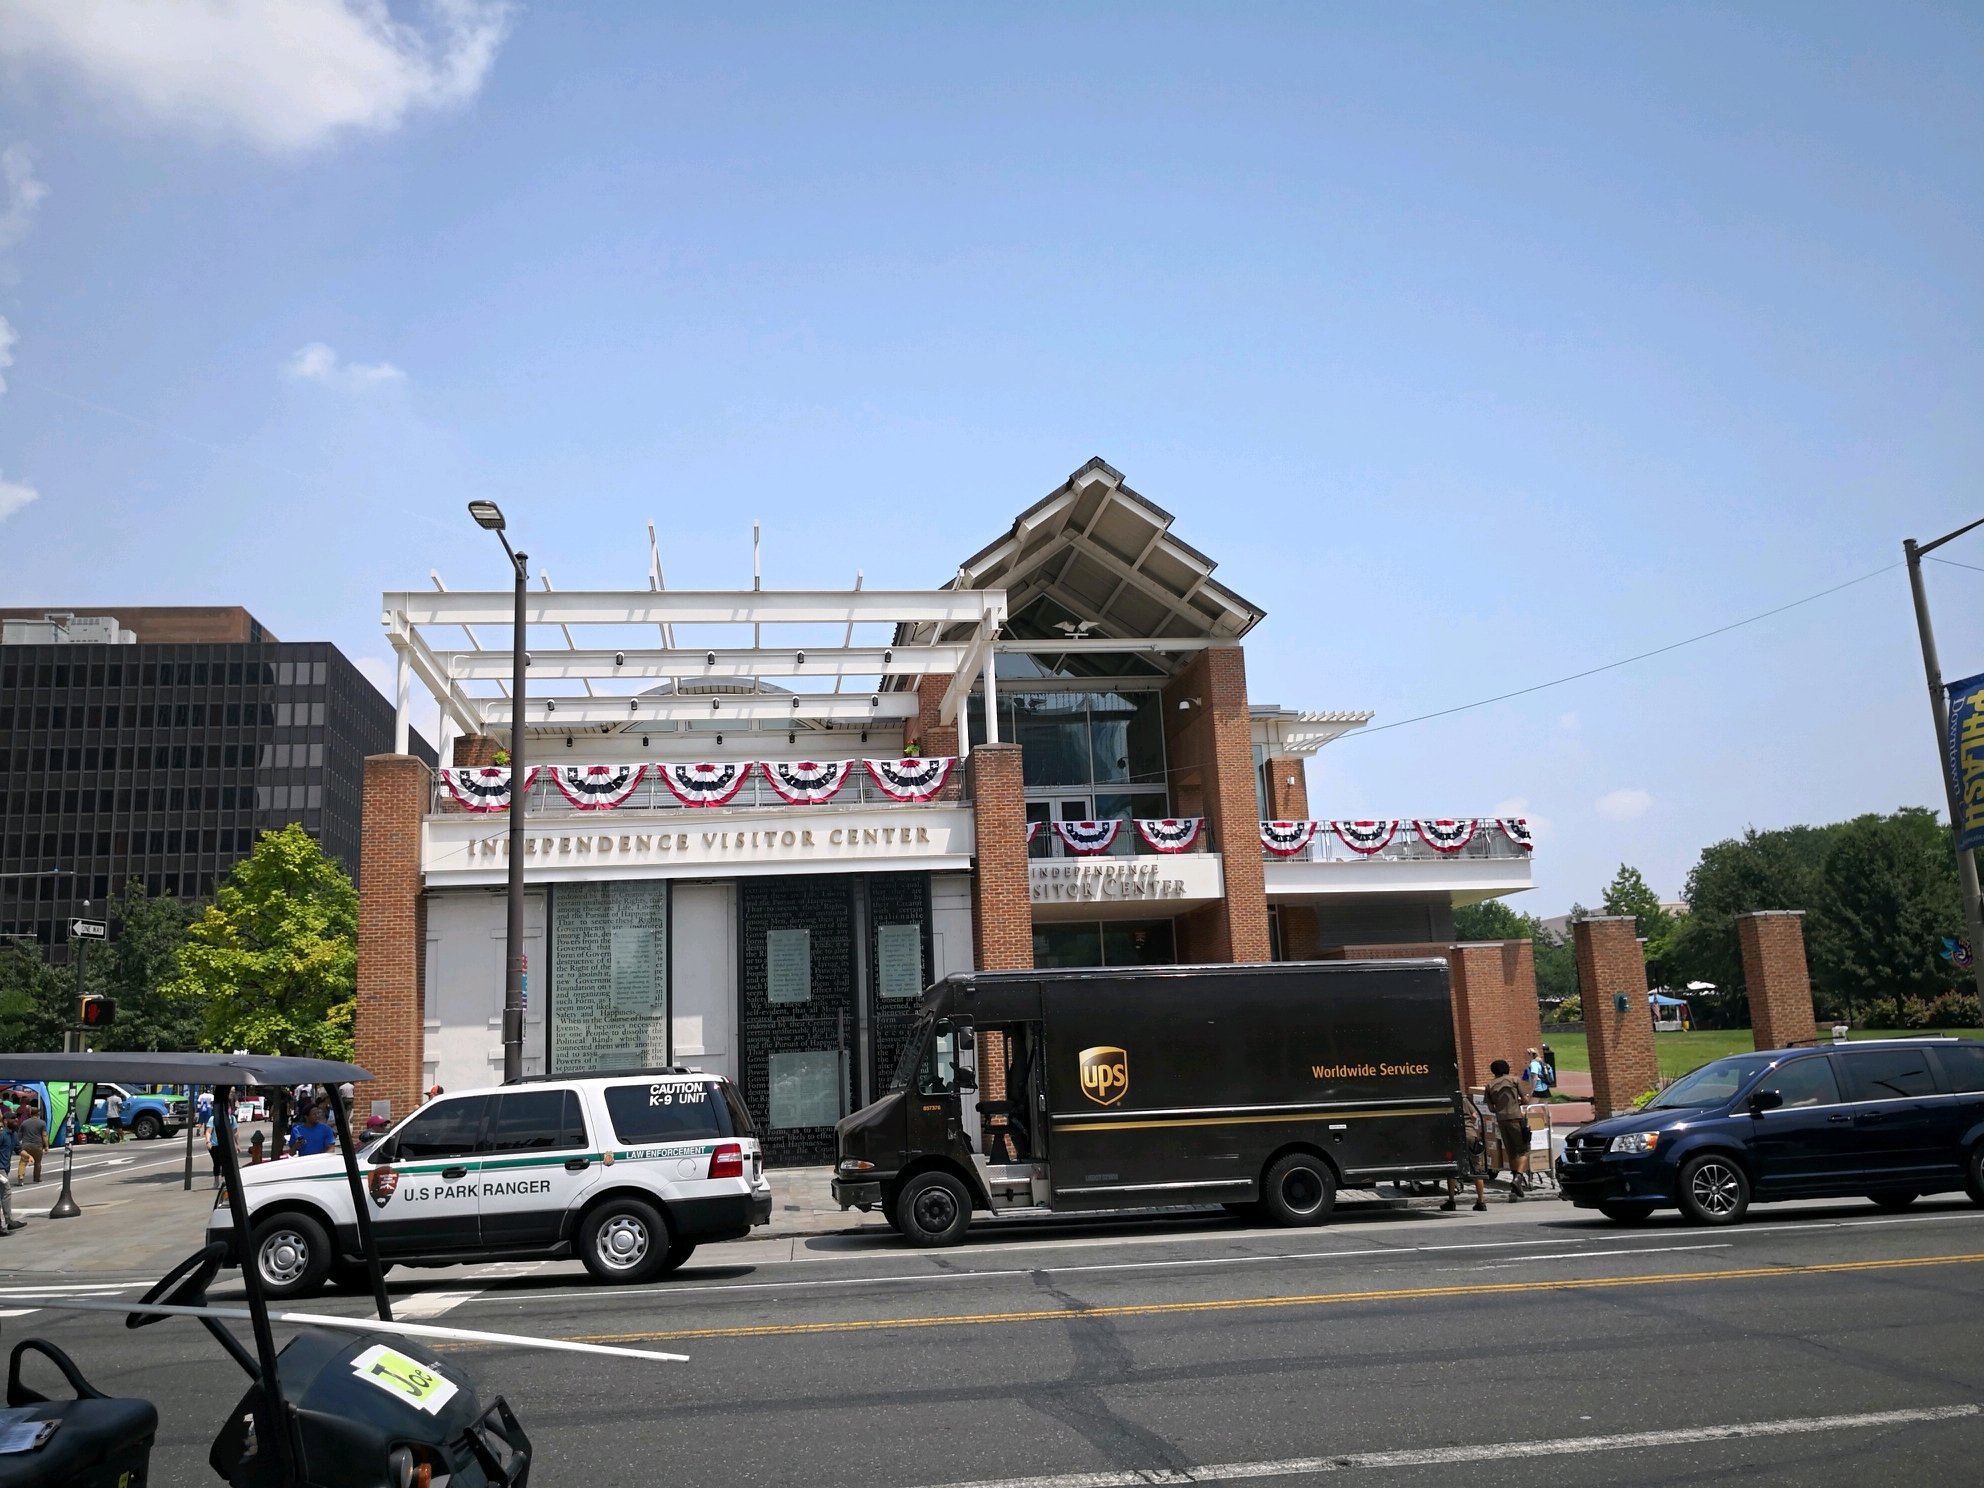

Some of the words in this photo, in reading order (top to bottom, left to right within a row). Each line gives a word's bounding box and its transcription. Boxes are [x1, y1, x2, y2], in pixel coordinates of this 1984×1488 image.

[1951, 695, 1966, 796] Downtown
[468, 833, 689, 857] INEPENDENCE
[702, 829, 815, 849] VISITOR
[829, 826, 930, 845] CENTER
[1032, 863, 1160, 879] INDEPENDENCE
[1103, 878, 1188, 897] CENTER
[1083, 1063, 1125, 1097] ups
[1312, 1064, 1377, 1079] Worldwide
[1379, 1062, 1430, 1076] Services
[650, 1082, 703, 1095] CAUTION
[649, 1094, 673, 1107] K-9
[679, 1092, 707, 1104] UNIT
[626, 1151, 645, 1160] LAW
[646, 1146, 706, 1158] ENFORCEMENT
[404, 1188, 430, 1202] U.S
[434, 1184, 479, 1199] PARK
[483, 1180, 551, 1196] RANGER
[370, 1363, 433, 1397] Joe
